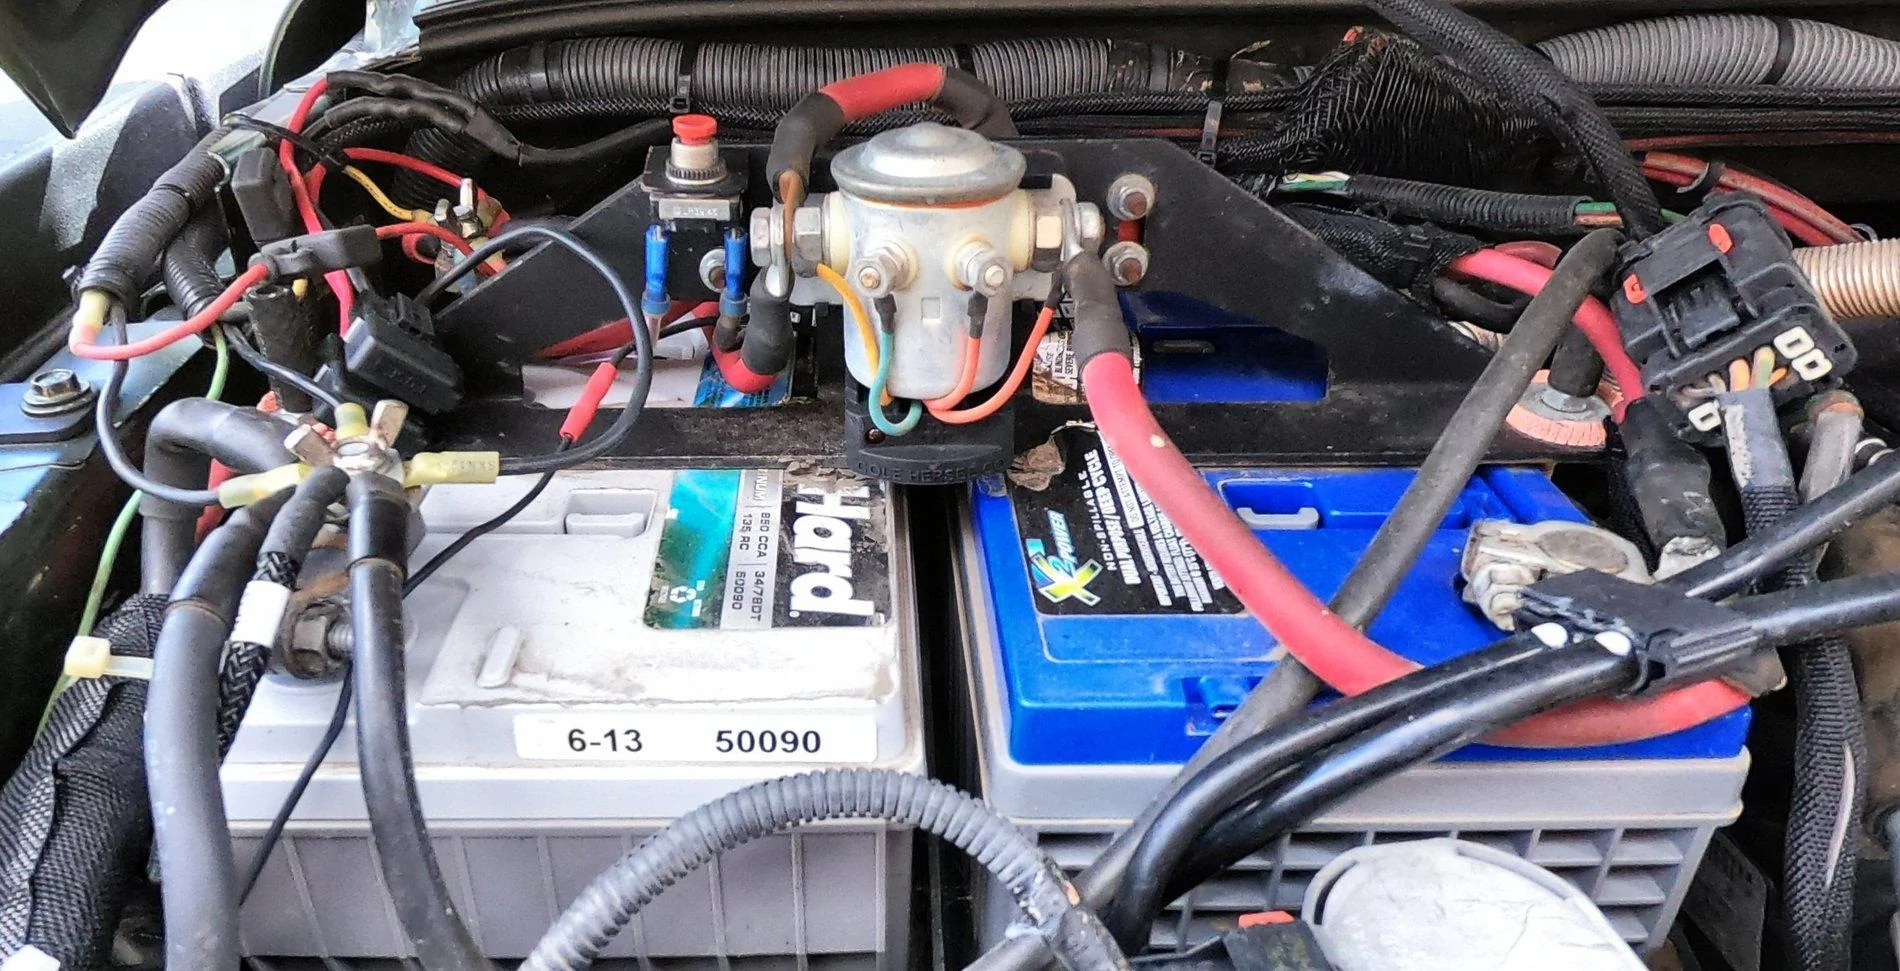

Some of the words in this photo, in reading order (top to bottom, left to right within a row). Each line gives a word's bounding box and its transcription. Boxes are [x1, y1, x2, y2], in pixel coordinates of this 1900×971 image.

[857, 460, 900, 480] COLE
[1083, 449, 1107, 488] CYCLE
[1124, 500, 1136, 513] NOT
[739, 513, 752, 532] 135
[760, 512, 771, 533] 850
[739, 535, 751, 551] RC
[757, 535, 769, 559] CCA
[1119, 558, 1141, 585] DUAL
[732, 571, 746, 611] 50090
[750, 570, 766, 622] 34/78DT
[567, 729, 643, 753] 6-13
[715, 730, 822, 754] 50090
